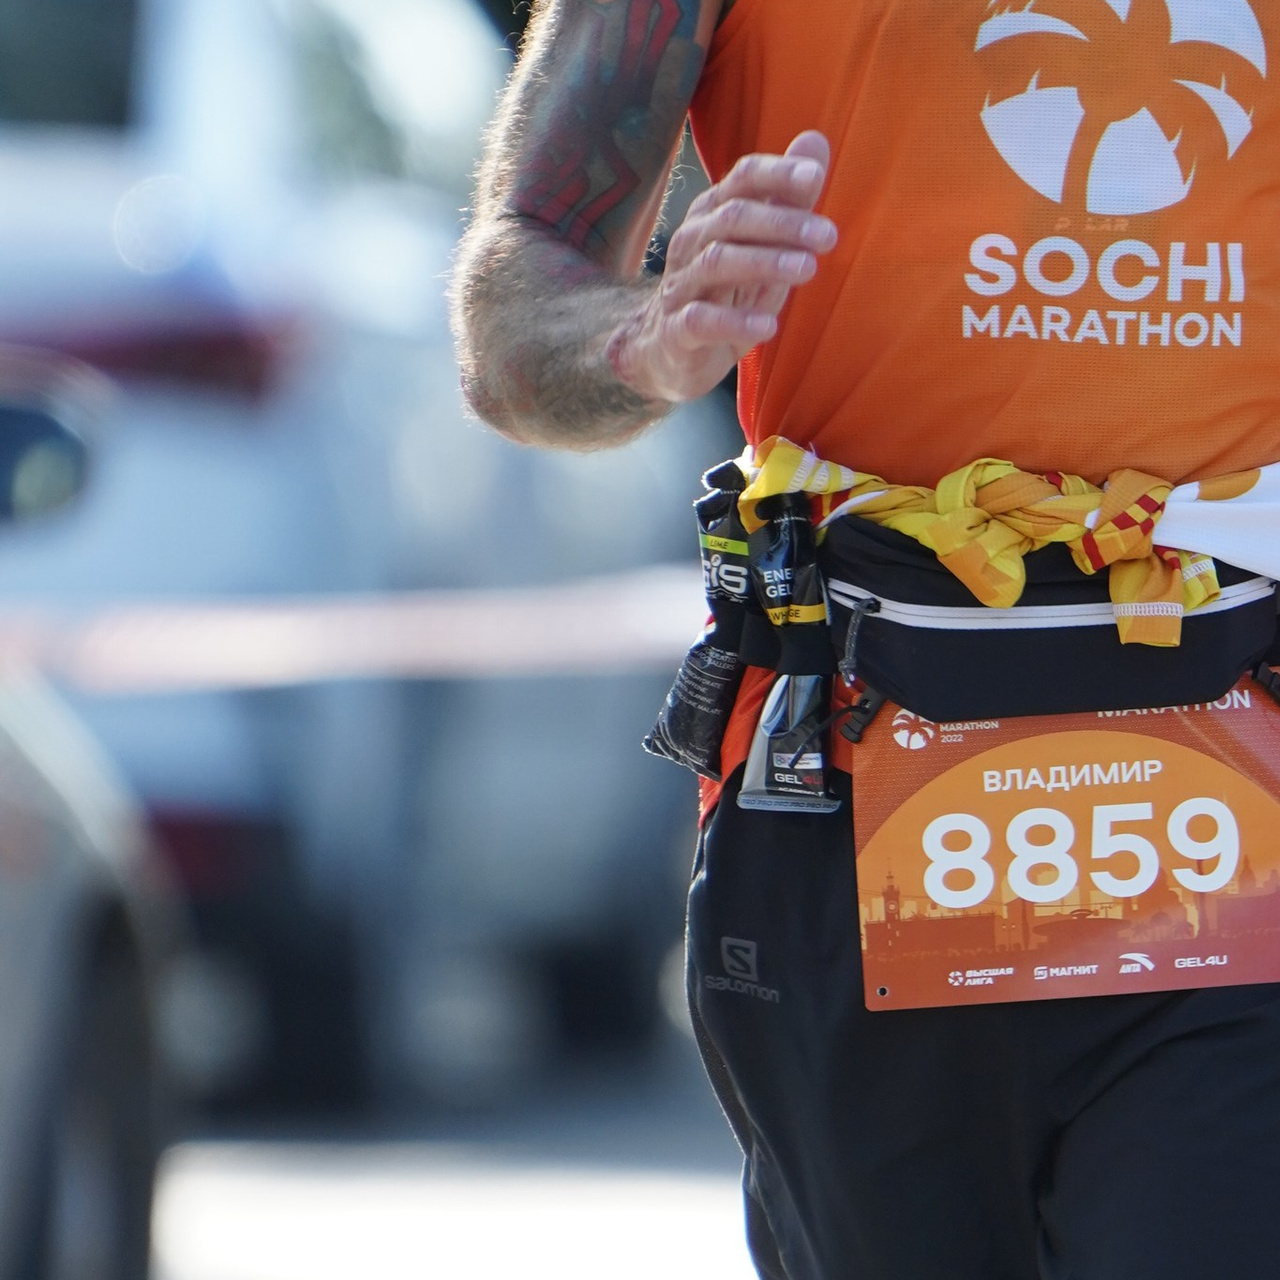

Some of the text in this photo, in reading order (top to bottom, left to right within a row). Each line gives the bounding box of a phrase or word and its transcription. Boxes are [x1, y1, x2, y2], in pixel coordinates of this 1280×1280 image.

[964, 233, 1245, 302] SOCHI
[962, 305, 1242, 347] MARATHON
[940, 721, 999, 732] MARATHON
[941, 734, 964, 743] 2022
[983, 759, 1163, 793] ВЛАДИМИР
[922, 797, 1240, 909] 8859
[1174, 955, 1228, 968] GEL4U
[965, 967, 1014, 977] ВЫСШАЯ
[1049, 965, 1098, 977] МАГНИТ
[964, 977, 994, 986] ЛИГА
[704, 975, 779, 1004] salomon
